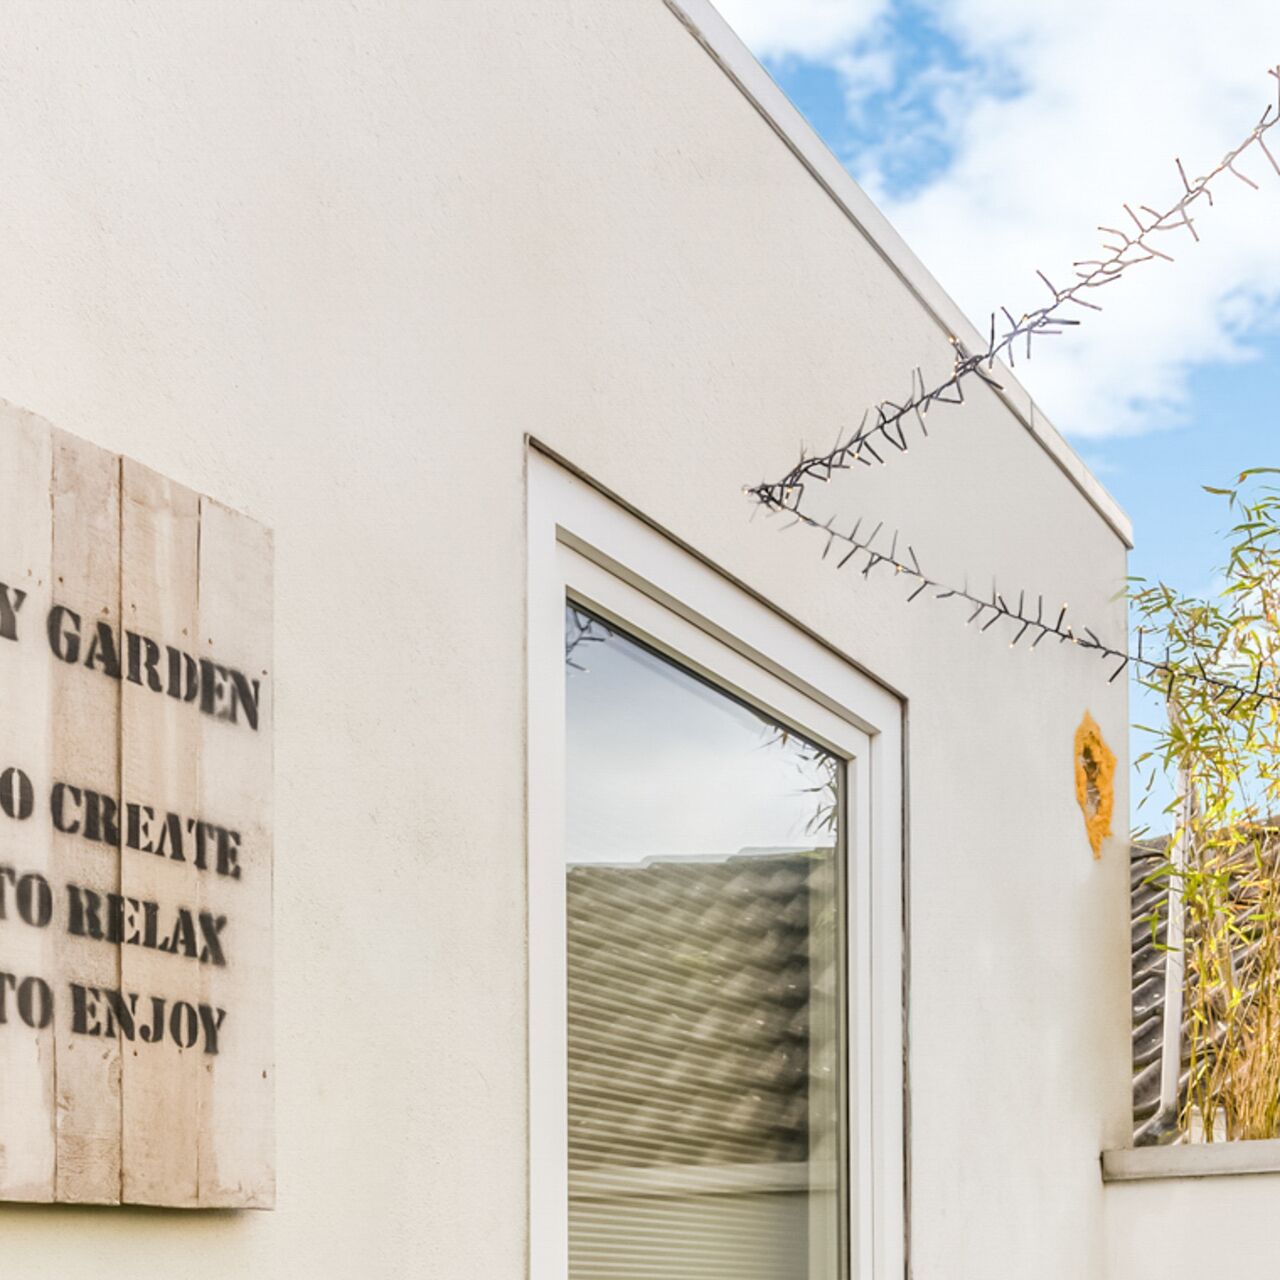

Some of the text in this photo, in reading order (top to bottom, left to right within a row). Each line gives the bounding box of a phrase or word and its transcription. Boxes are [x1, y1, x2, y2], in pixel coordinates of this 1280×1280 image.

[47, 604, 260, 731] GARDEN
[51, 781, 242, 880] CREATE
[66, 883, 228, 968] RELAX
[69, 982, 227, 1055] ENJOY
